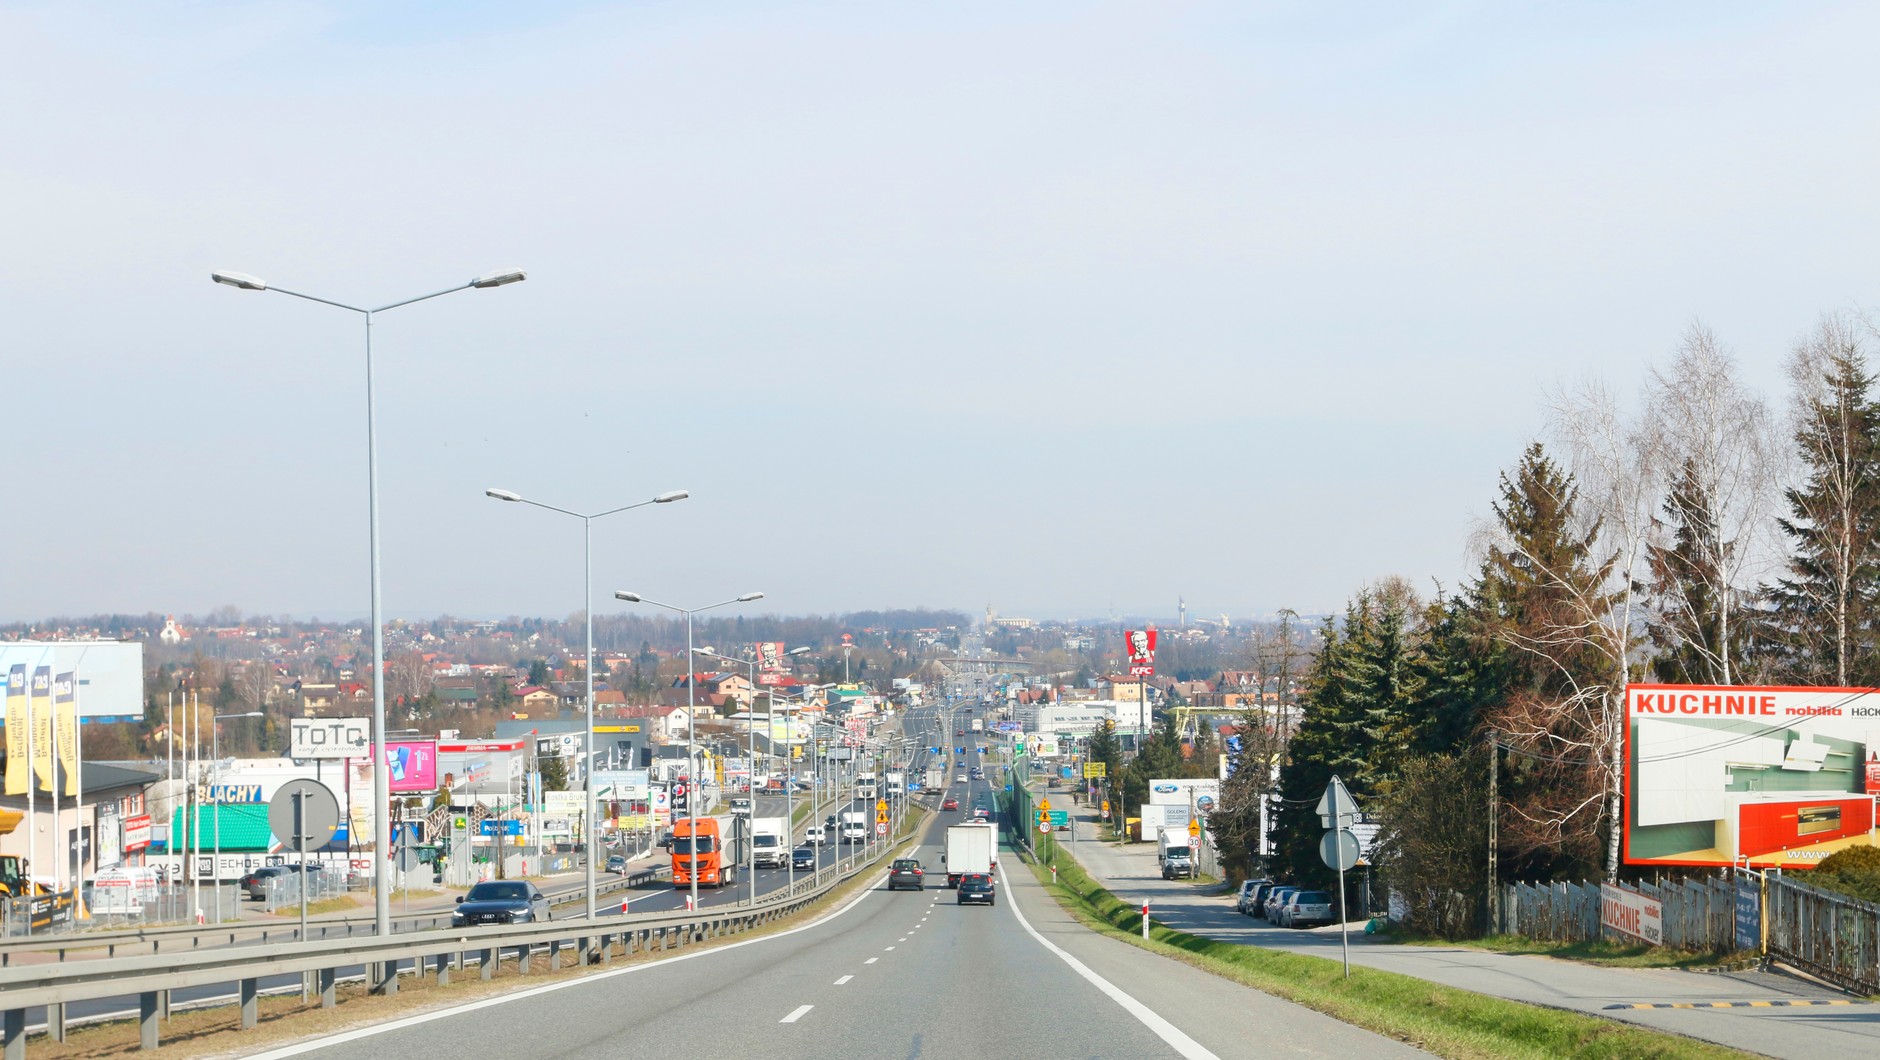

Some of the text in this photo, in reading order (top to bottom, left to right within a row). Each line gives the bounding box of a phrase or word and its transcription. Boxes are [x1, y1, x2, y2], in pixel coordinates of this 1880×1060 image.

[1131, 667, 1152, 675] KFC
[1637, 694, 1776, 716] KUCHNIE
[1786, 706, 1842, 716] nobilia
[197, 786, 258, 802] BLACHY
[1603, 898, 1640, 934] KUCHNIE
